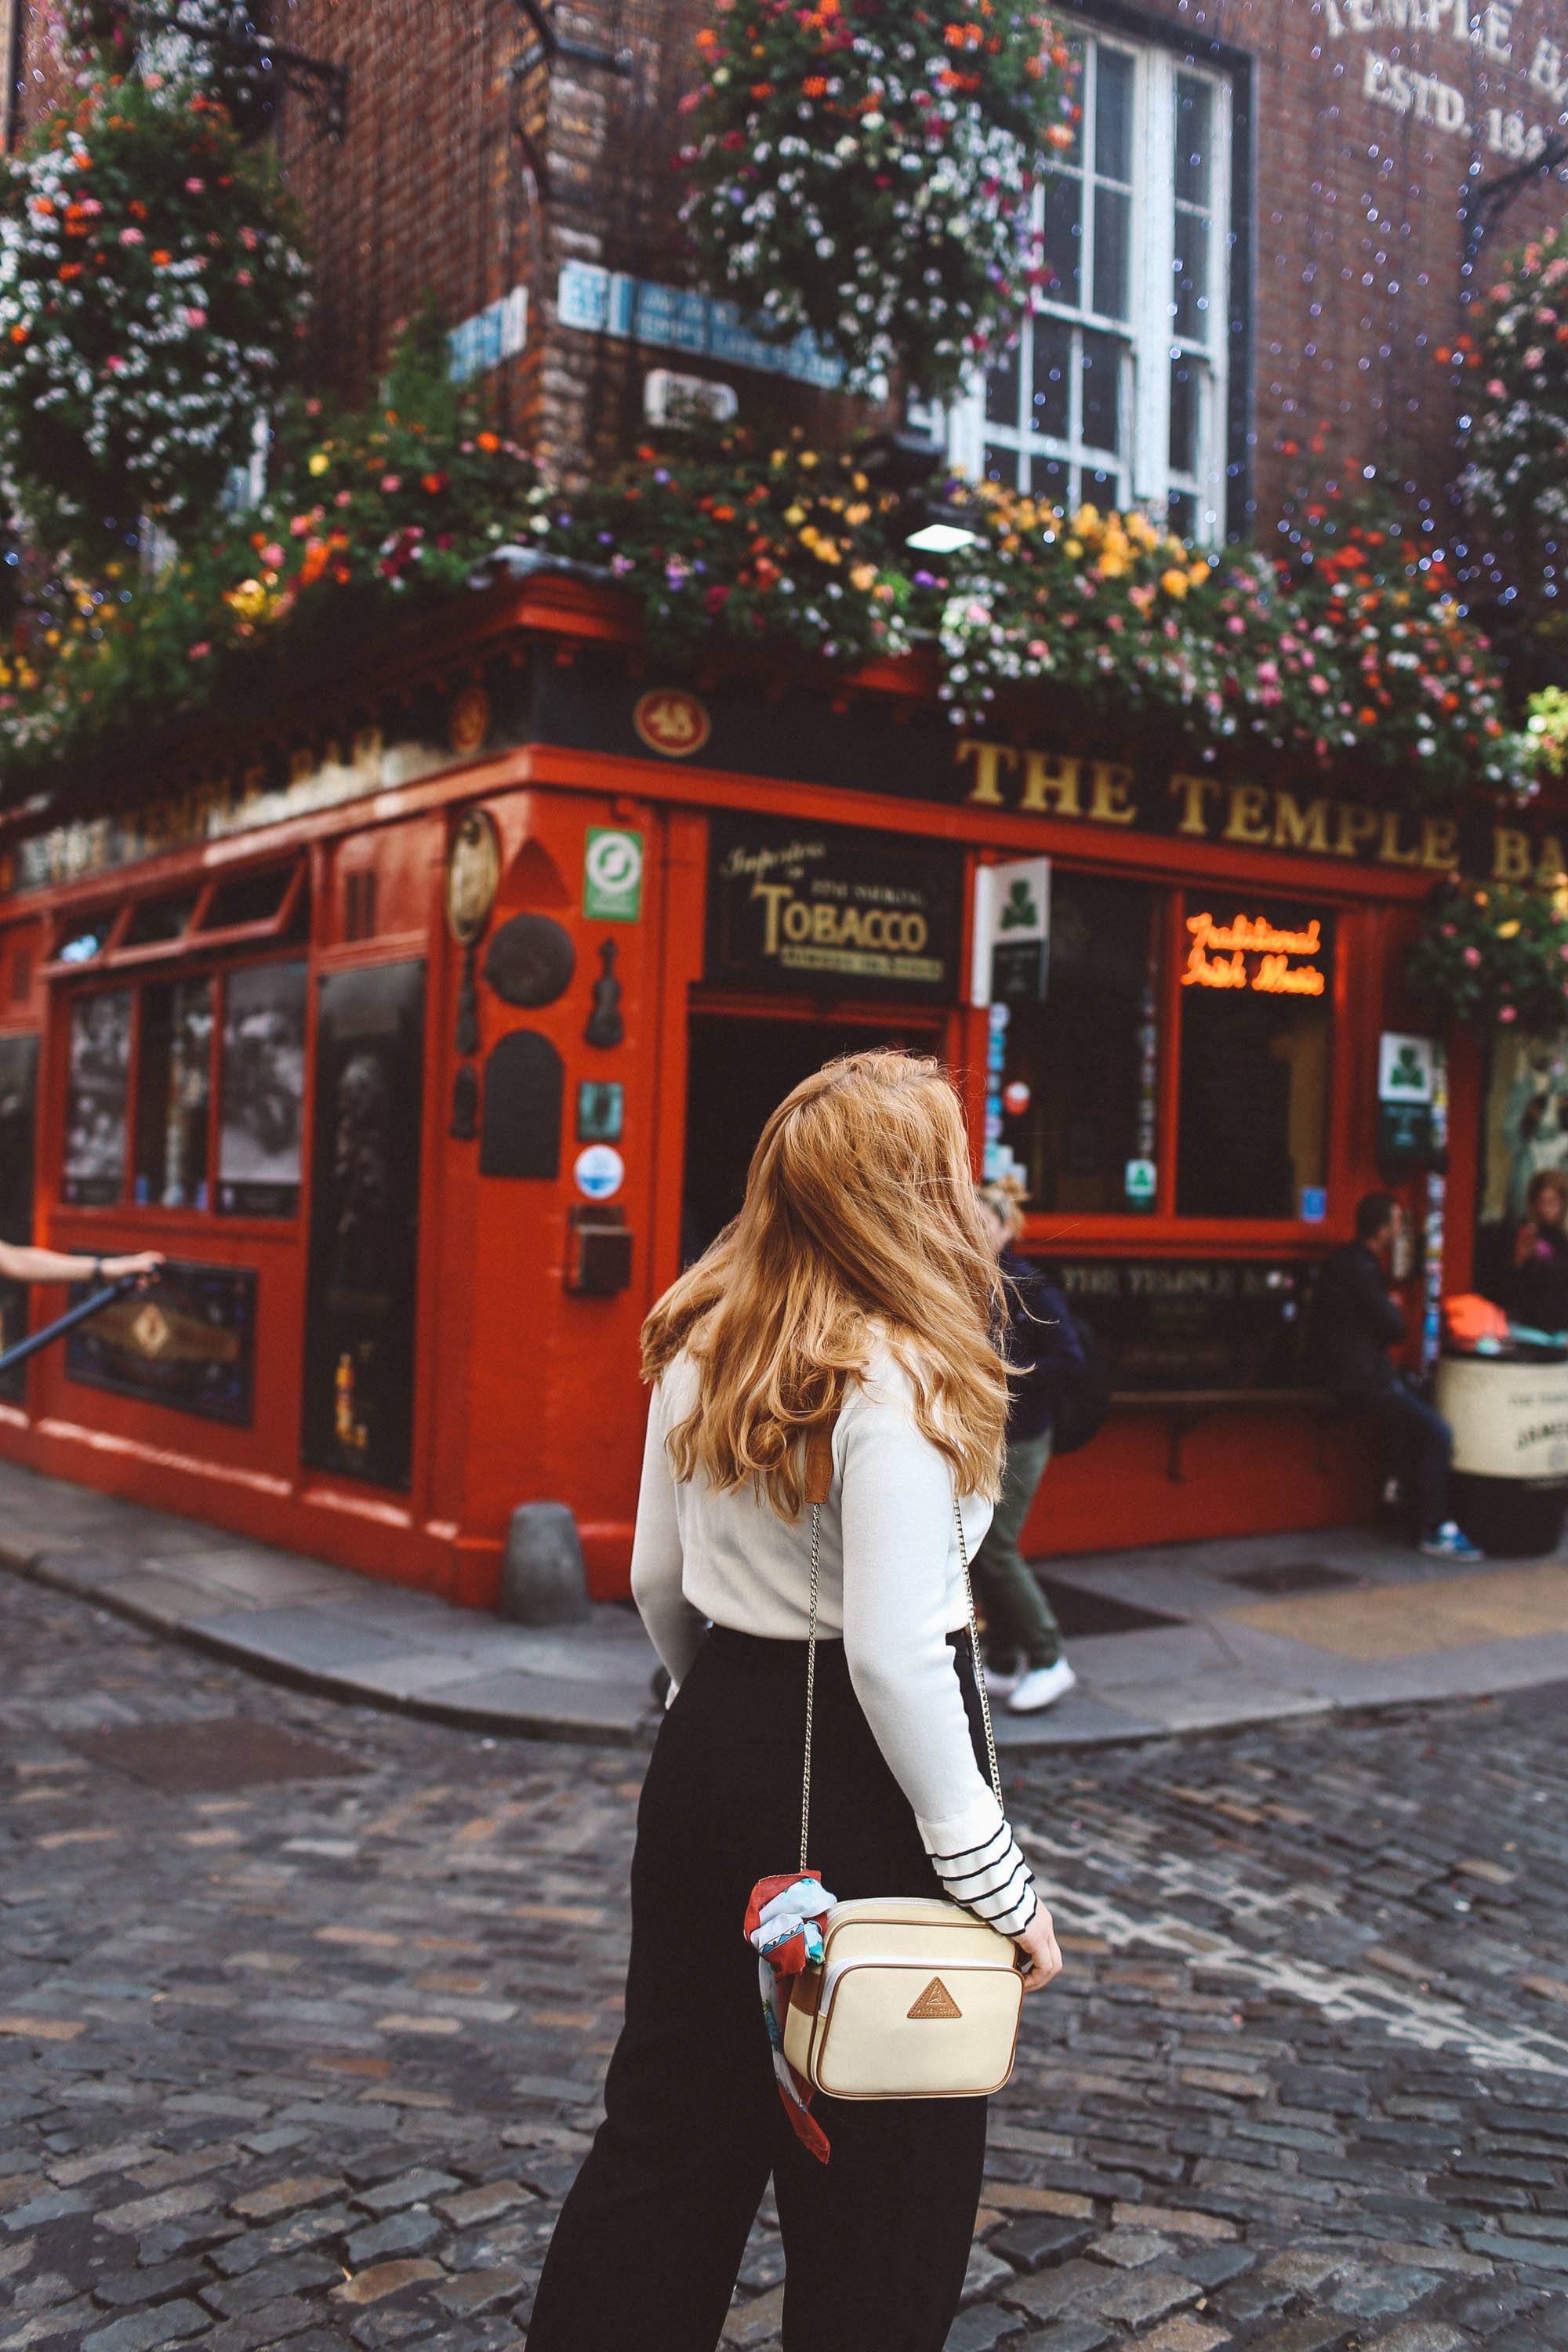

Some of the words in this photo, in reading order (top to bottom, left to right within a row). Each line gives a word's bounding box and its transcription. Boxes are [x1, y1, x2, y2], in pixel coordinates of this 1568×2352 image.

[1363, 50, 1473, 139] ESTD.
[956, 739, 1138, 826] THE
[1170, 772, 1459, 870] TEMPLE
